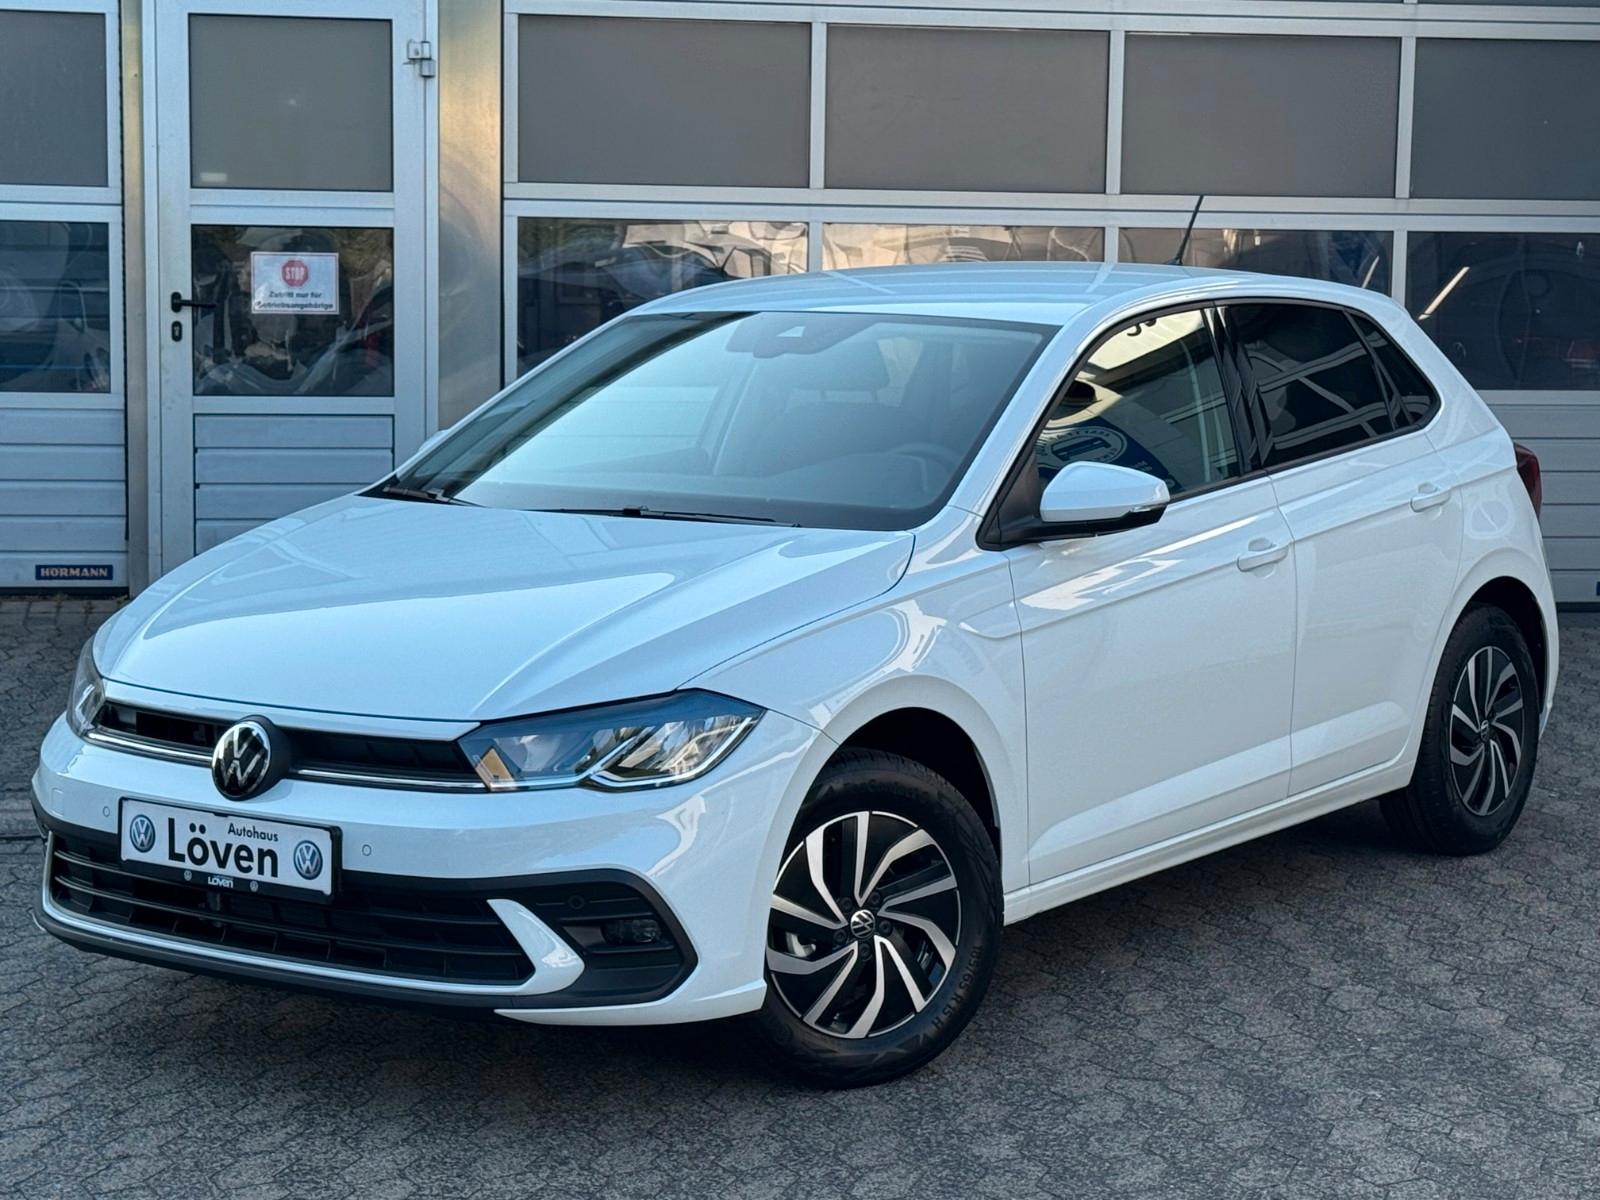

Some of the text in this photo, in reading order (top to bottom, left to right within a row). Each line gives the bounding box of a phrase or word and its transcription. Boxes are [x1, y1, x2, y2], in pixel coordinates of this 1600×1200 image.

[285, 267, 305, 280] STOP
[228, 822, 279, 842] Autohaus
[168, 817, 278, 878] Löven
